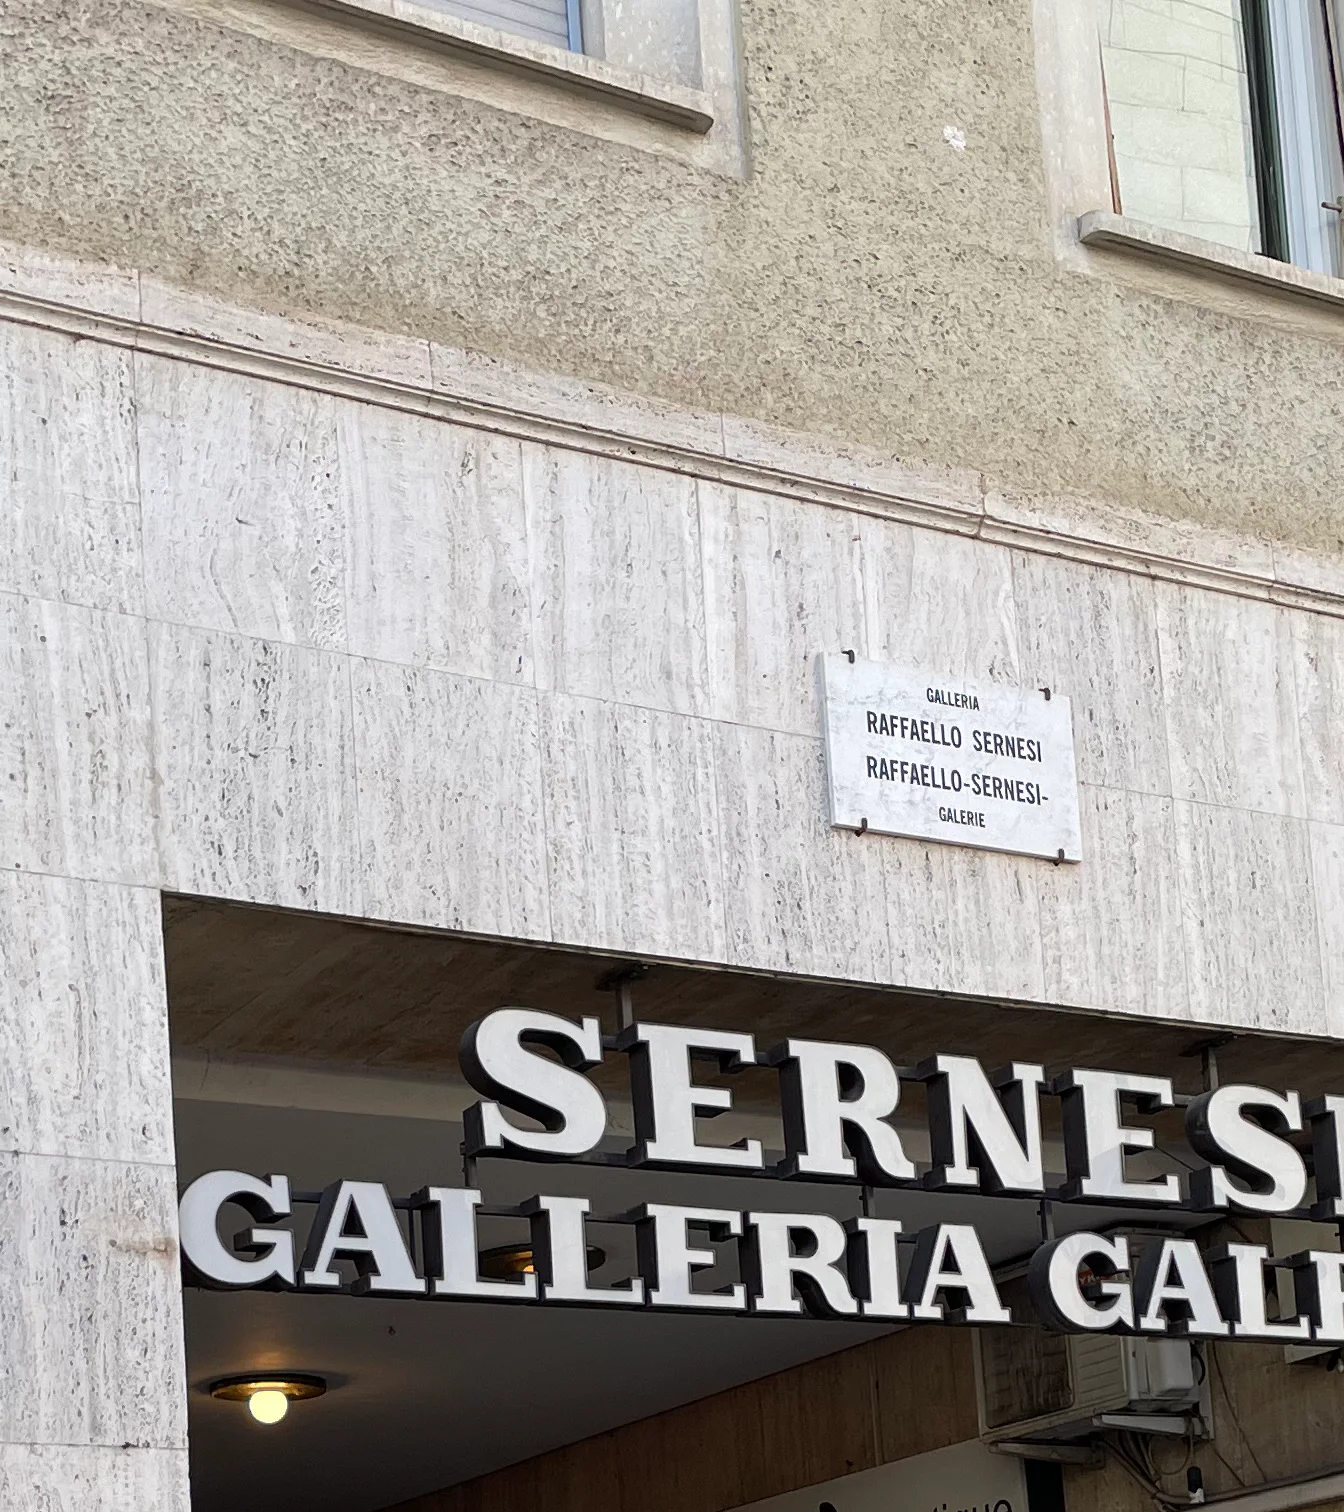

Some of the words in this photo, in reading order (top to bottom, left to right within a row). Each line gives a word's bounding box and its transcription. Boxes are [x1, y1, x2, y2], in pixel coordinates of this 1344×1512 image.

[926, 688, 980, 711] GALLERIA
[867, 711, 962, 748] RAFFAELLO
[972, 730, 1042, 762] SERNESI
[939, 807, 986, 827] GALERIE
[179, 1168, 1010, 1324] GALLERIA
